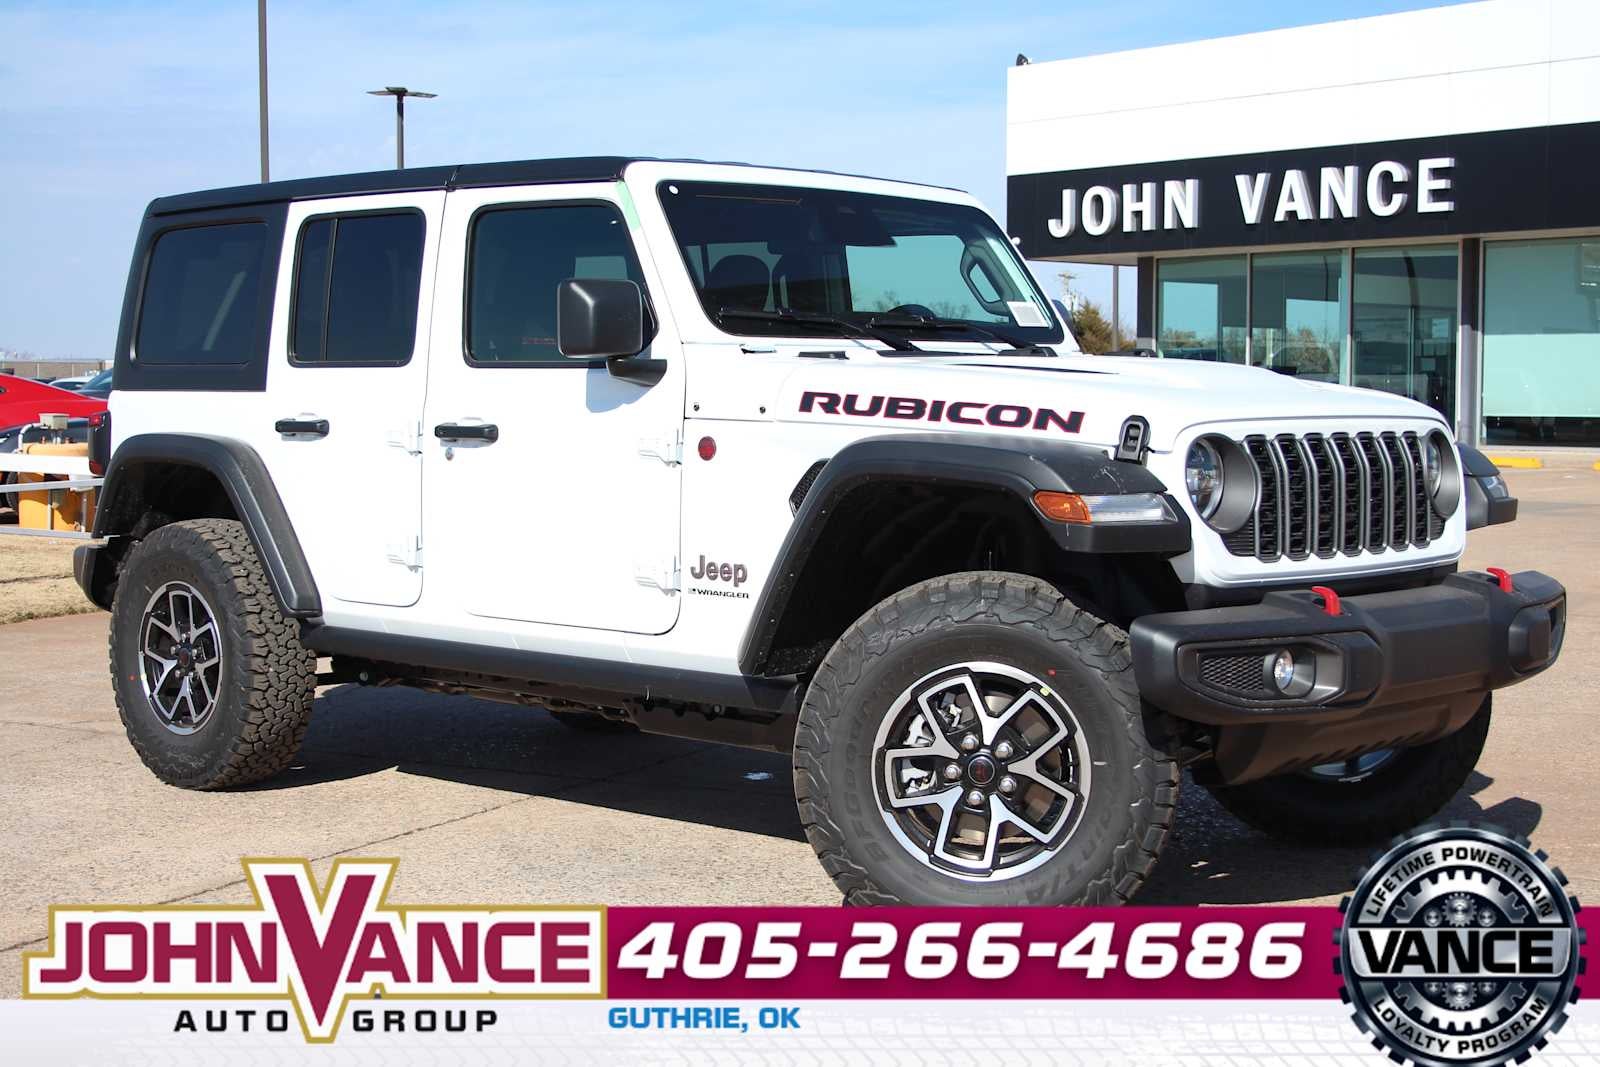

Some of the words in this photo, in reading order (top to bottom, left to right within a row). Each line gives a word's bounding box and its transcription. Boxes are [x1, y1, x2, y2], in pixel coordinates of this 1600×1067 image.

[1047, 178, 1199, 239] JOHN
[1234, 157, 1456, 225] VANCE
[799, 391, 1086, 434] RUBICON
[690, 554, 748, 588] Jeep
[696, 588, 750, 599] WRANGLER
